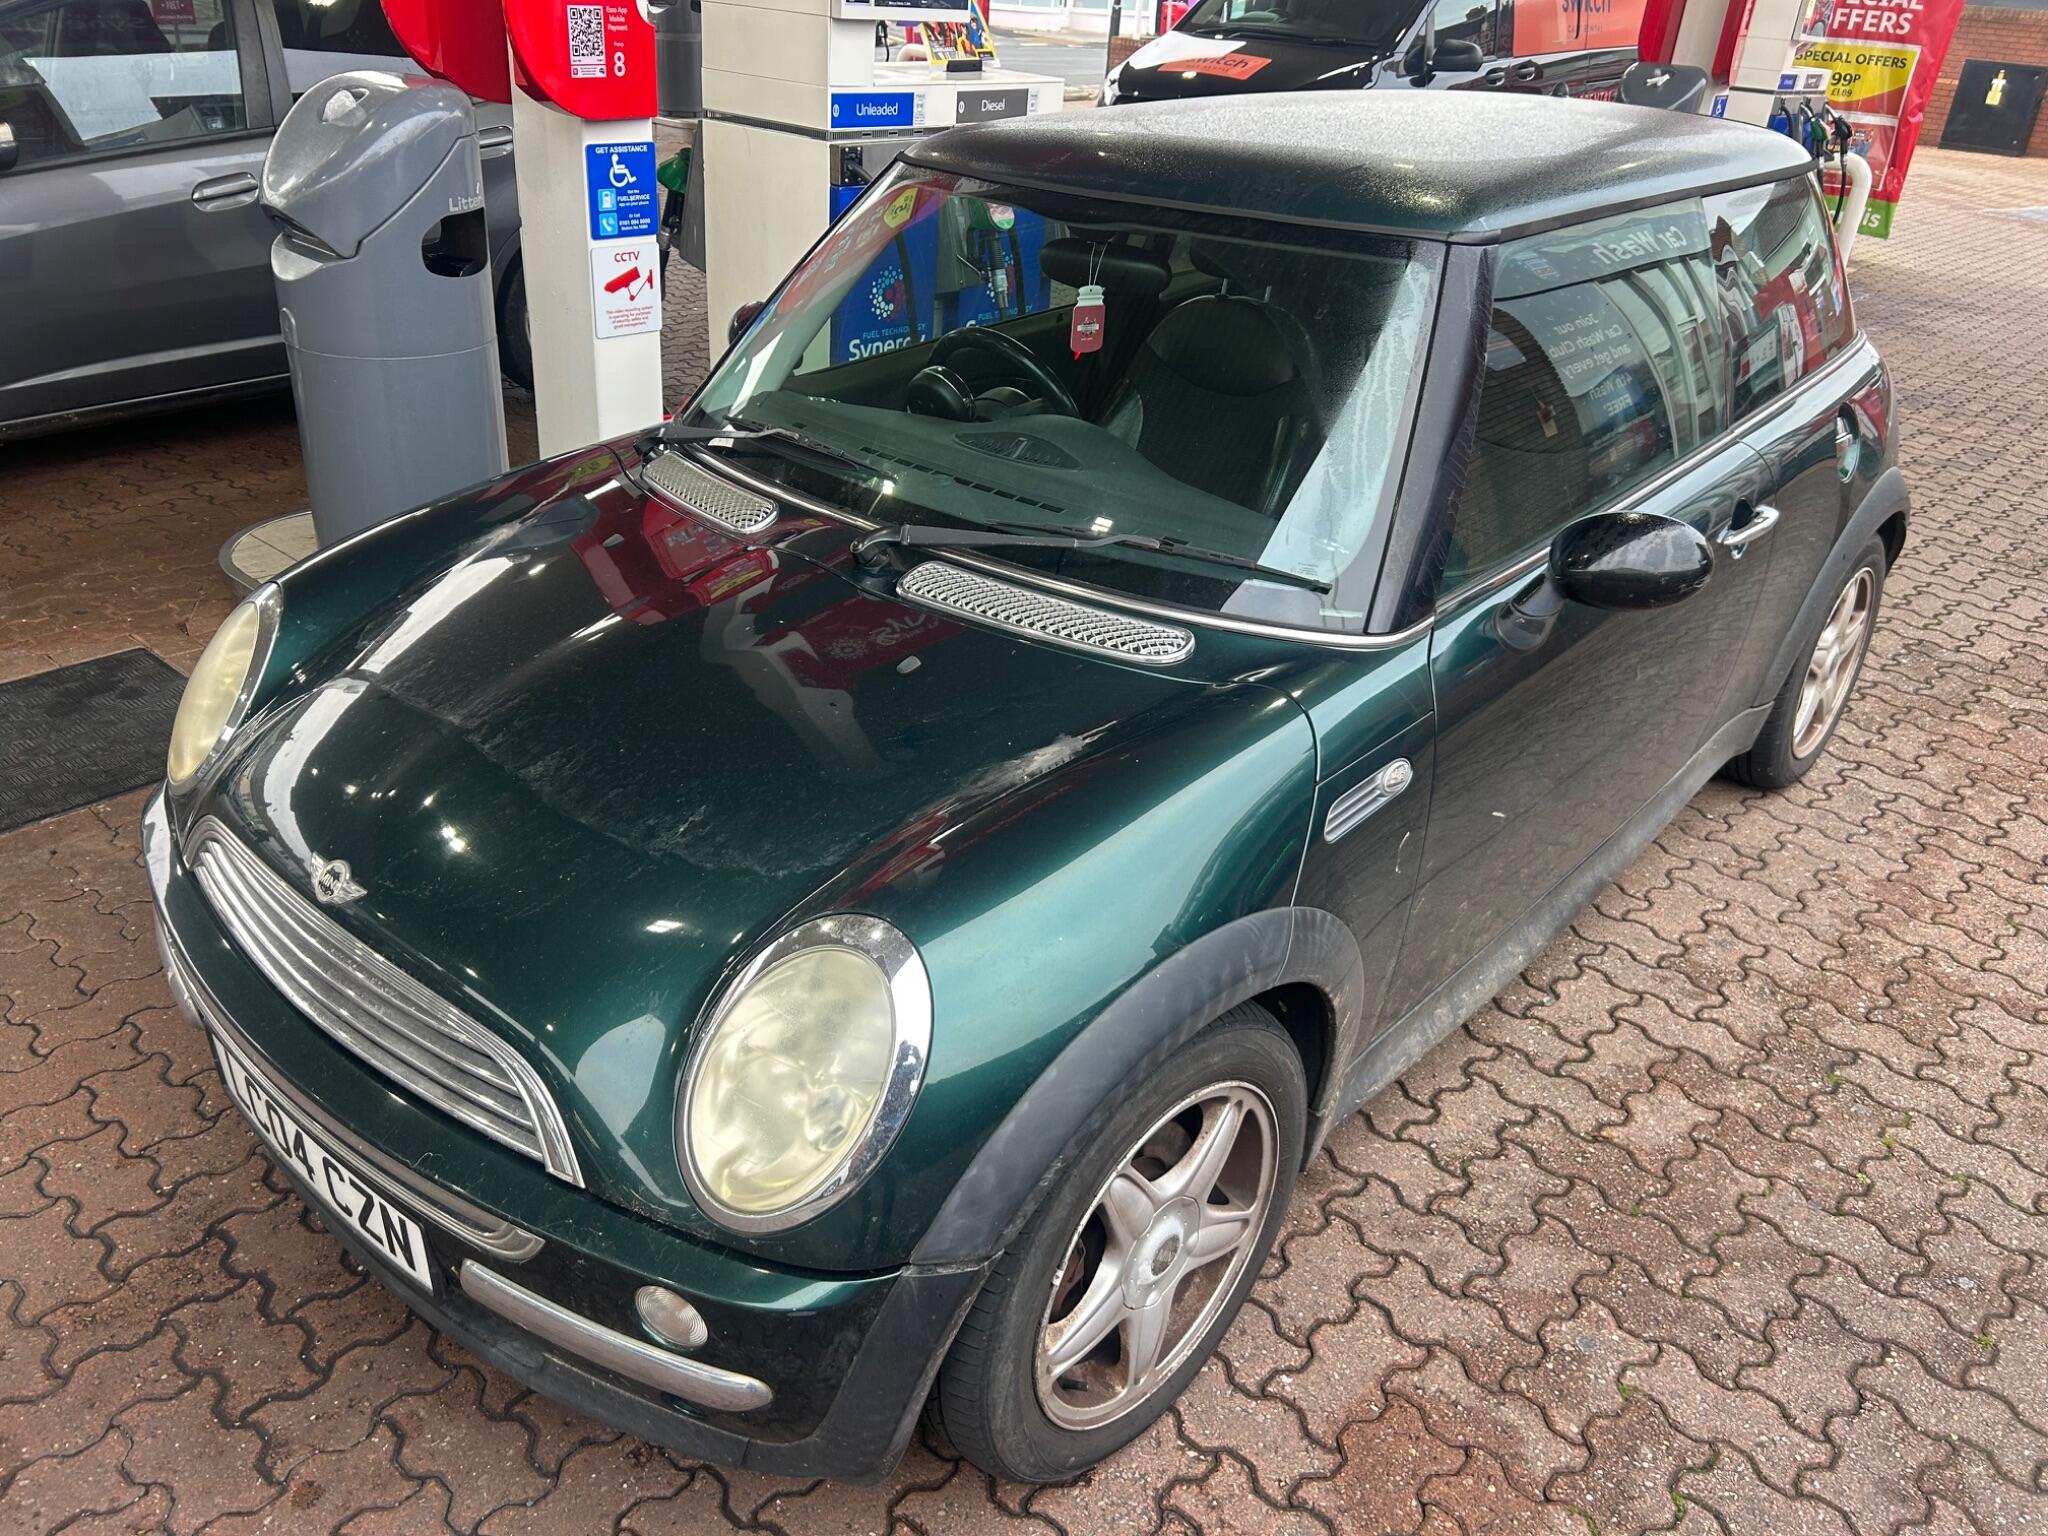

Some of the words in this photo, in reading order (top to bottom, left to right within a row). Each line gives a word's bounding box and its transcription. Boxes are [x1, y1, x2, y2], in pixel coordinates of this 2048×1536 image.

[618, 6, 628, 14] App
[608, 24, 628, 32] Payment
[1832, 8, 1914, 35] FFERS
[614, 51, 626, 77] 8
[1856, 53, 1908, 69] OFFERS
[856, 102, 898, 116] Unleaded
[981, 99, 1005, 112] Diesel
[610, 145, 648, 153] ASSISTANCE
[614, 251, 640, 262] CCTV
[863, 330, 880, 339] FUEL
[322, 1156, 417, 1272] CZN
